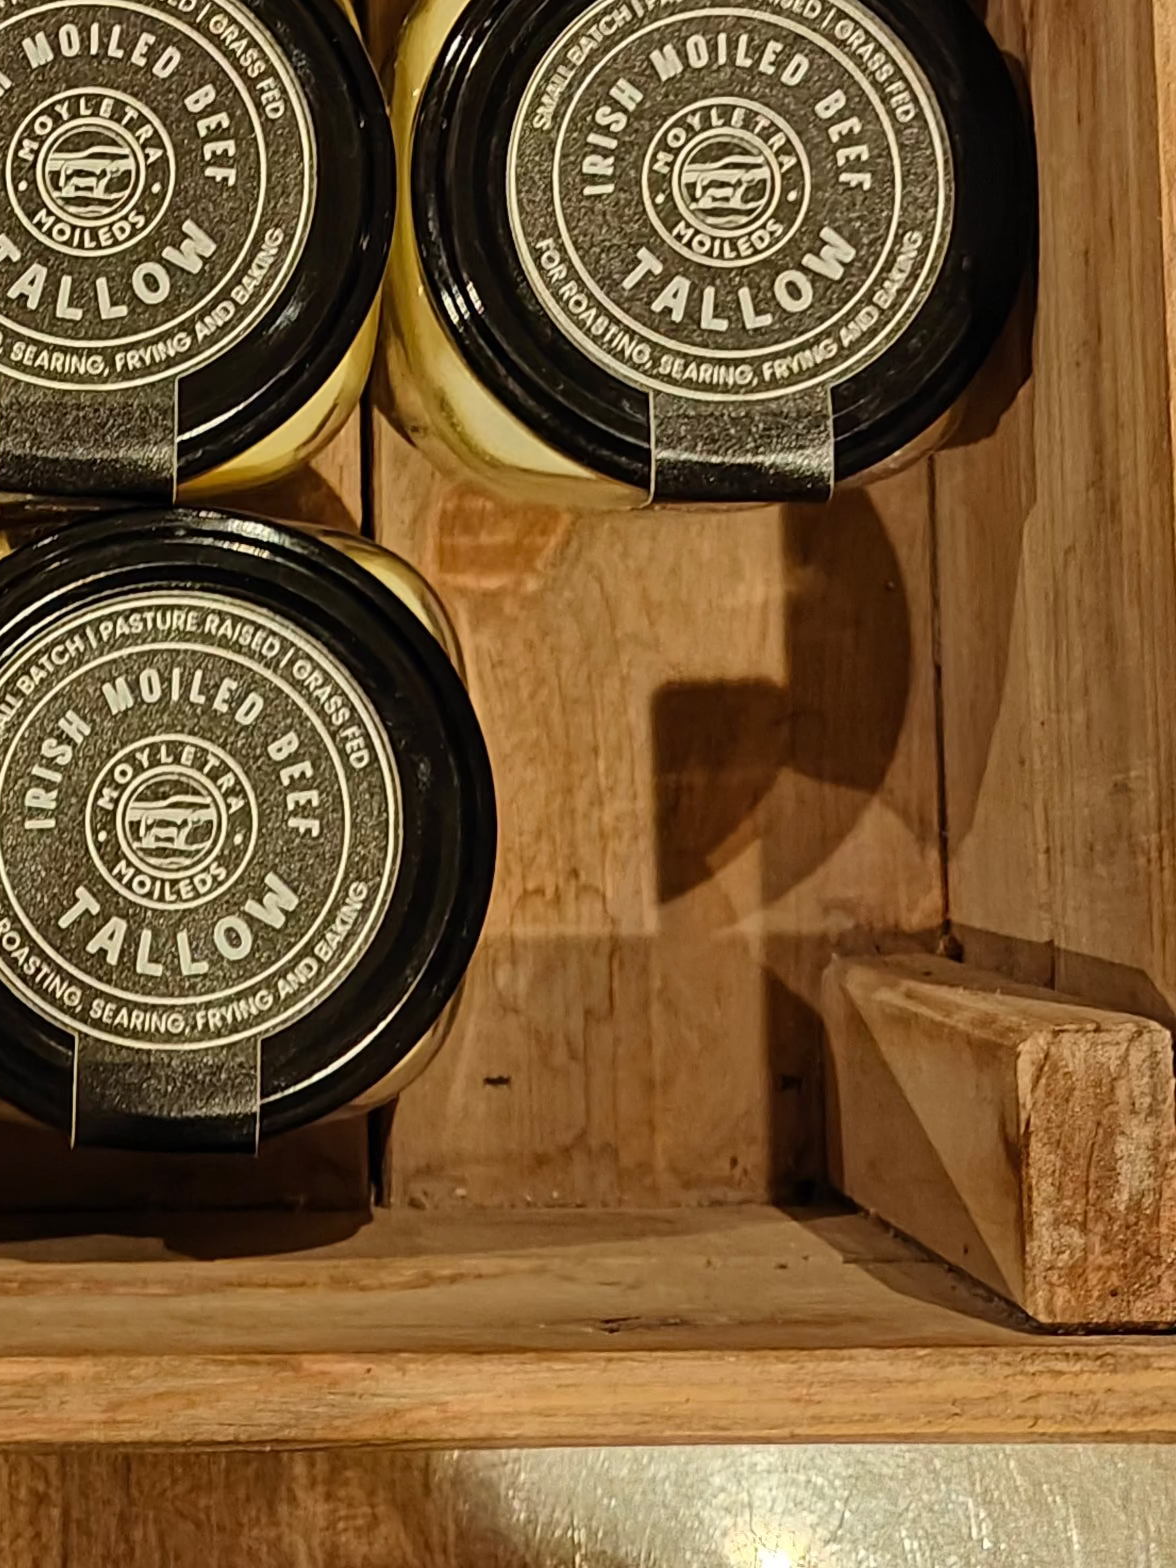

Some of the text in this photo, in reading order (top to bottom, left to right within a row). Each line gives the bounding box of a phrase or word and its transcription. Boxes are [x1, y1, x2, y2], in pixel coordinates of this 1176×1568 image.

[22, 21, 181, 78] MOILED
[184, 83, 236, 186] BEEF
[209, 14, 266, 78] GRASS
[256, 77, 285, 120] FED
[583, 32, 871, 195] IRISH MOILED BEEF
[18, 96, 163, 165] MOYLETRA
[33, 208, 145, 248] MOILEDS
[623, 225, 856, 331] TALLOW
[114, 331, 190, 373] FRYING
[194, 300, 234, 342] AND
[230, 228, 283, 306] BAKING
[24, 666, 320, 837] IRISH MOILED BEEF
[98, 743, 246, 816] MOYLETRA
[58, 871, 299, 976] TALLOW
[112, 859, 227, 901] MOILEDS
